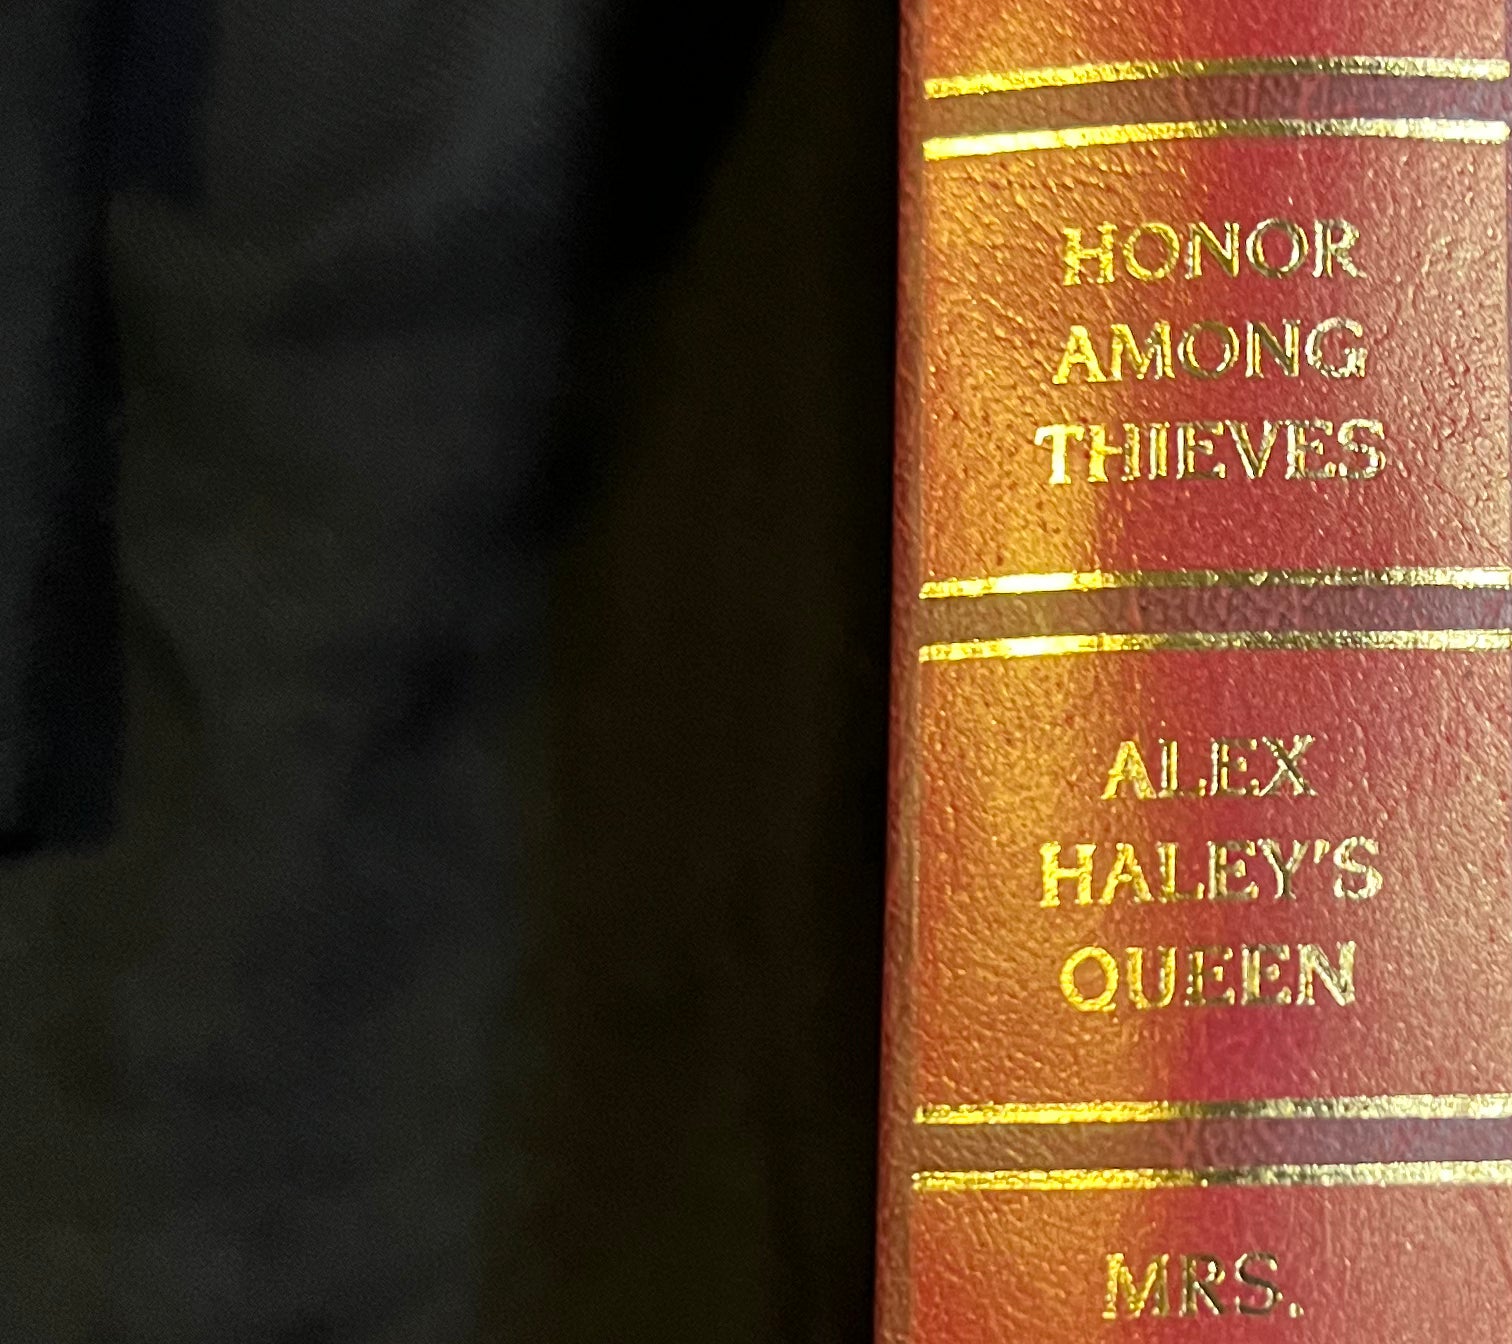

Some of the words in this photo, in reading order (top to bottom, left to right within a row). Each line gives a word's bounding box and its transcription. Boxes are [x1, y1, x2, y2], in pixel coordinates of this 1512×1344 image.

[1061, 217, 1367, 287] HONOR
[1051, 316, 1369, 385] AMONG
[1033, 417, 1388, 486] THIEVES
[1100, 734, 1319, 802] ALEX
[1038, 836, 1385, 908] HALEY'S
[1059, 940, 1357, 1014] QUEEN
[1101, 1251, 1305, 1320] MRS.
